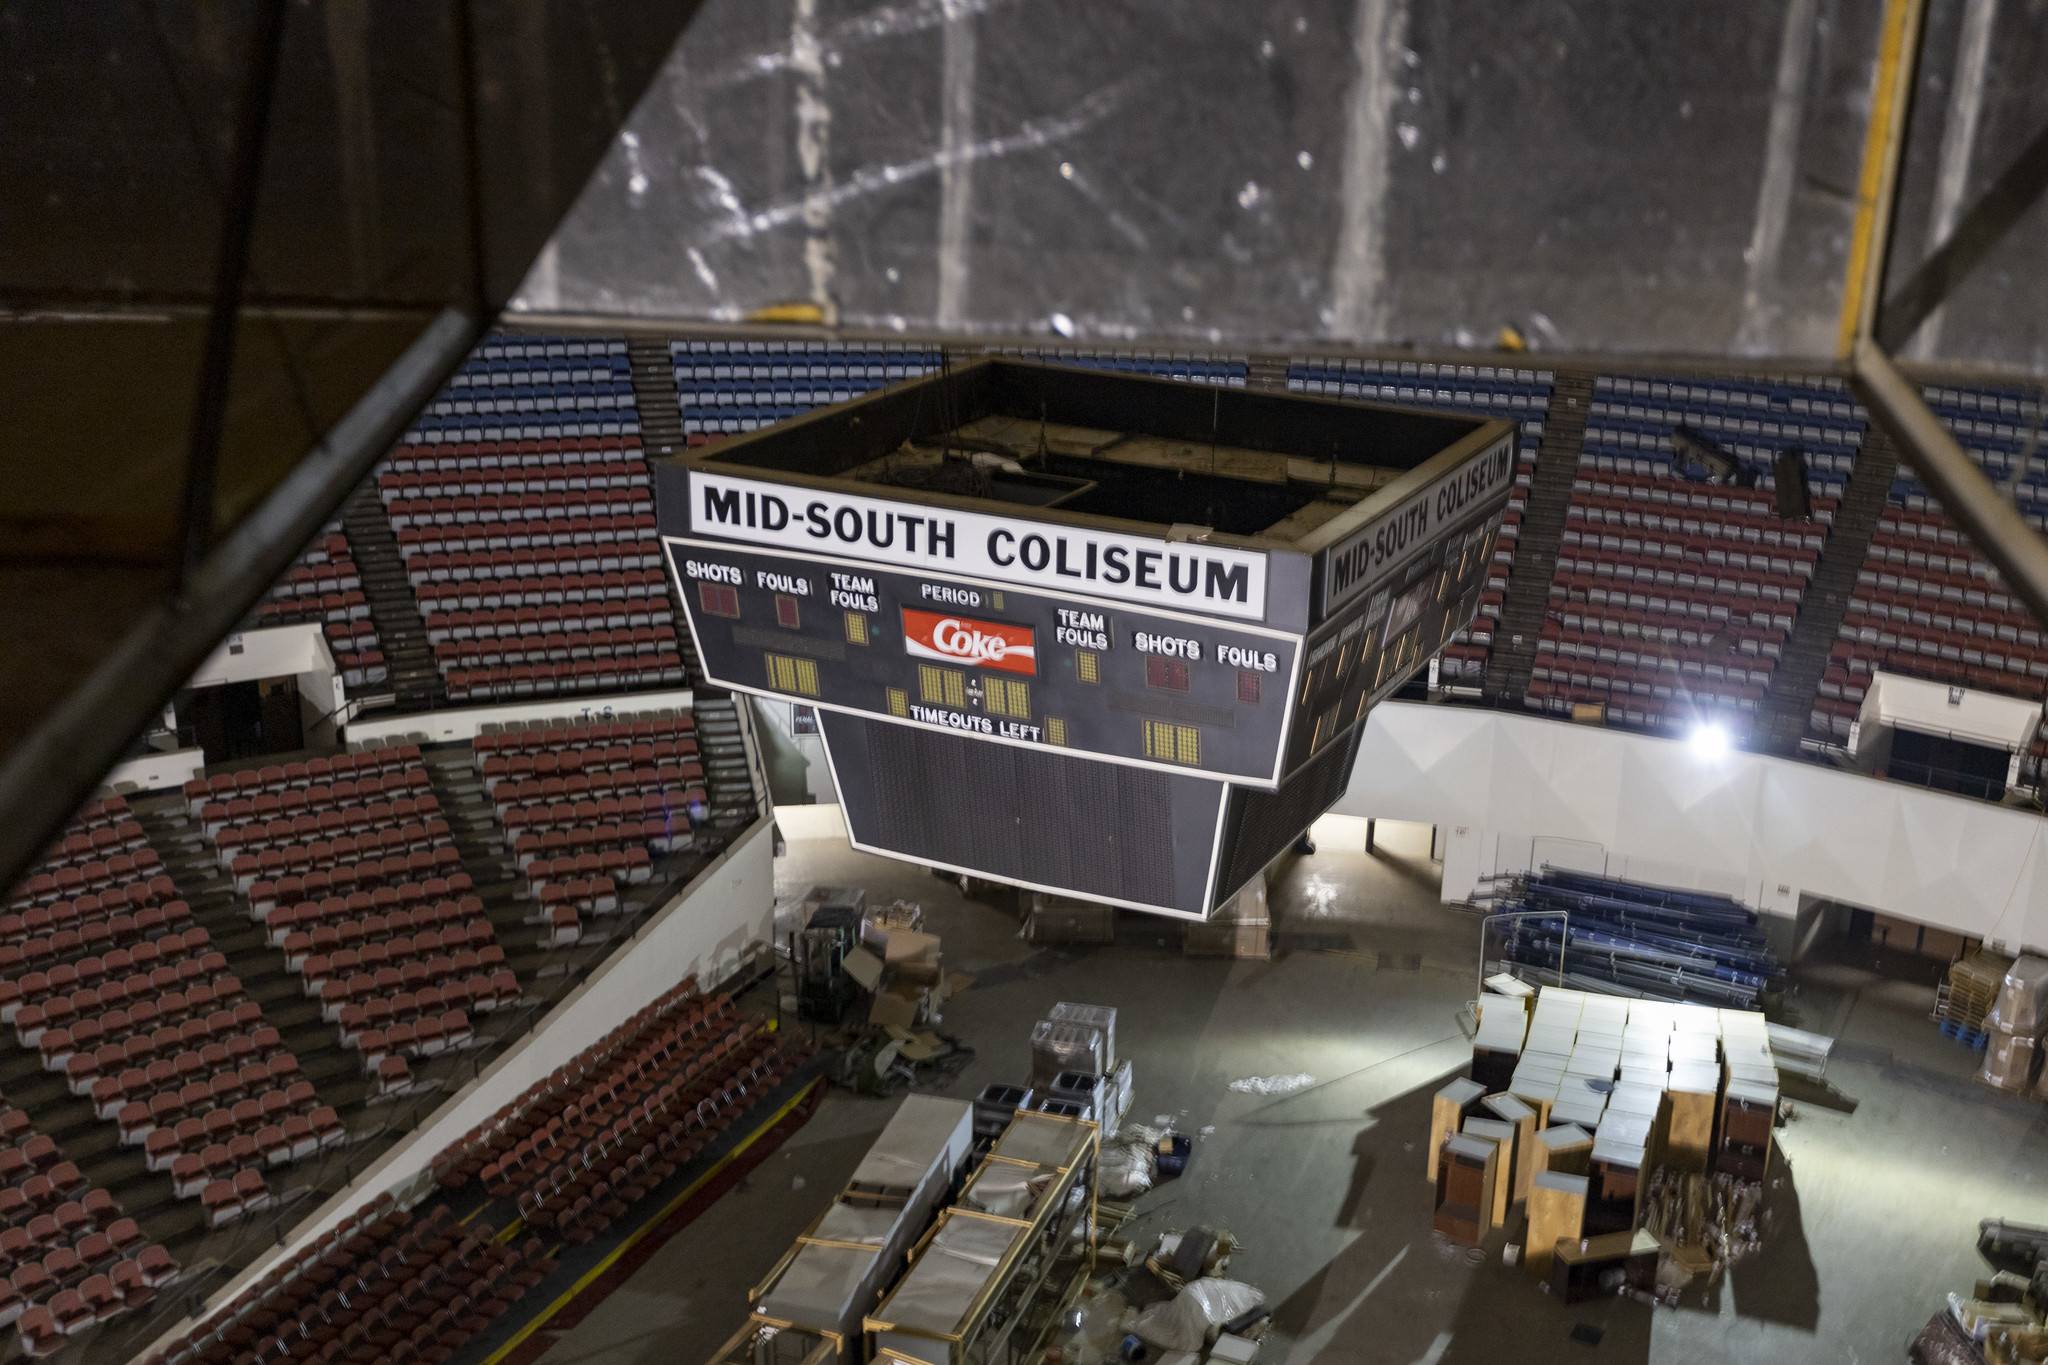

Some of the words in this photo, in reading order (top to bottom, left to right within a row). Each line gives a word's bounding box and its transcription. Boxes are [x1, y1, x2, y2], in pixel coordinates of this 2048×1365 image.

[1333, 496, 1429, 596] MID-SOUTH
[1437, 445, 1509, 521] COLISEUM
[703, 485, 955, 558] MID-SOUTH
[986, 527, 1250, 603] COLISEUM
[685, 560, 743, 585] SHOTS
[756, 571, 809, 596] FOULS
[830, 573, 874, 594] TEAM
[830, 589, 879, 612] FOULS
[921, 583, 981, 607] PERIOD
[1057, 608, 1104, 632] TEAM
[932, 618, 1006, 662] Coke
[1056, 626, 1108, 650] FOULS
[1135, 632, 1200, 660] SHOTS
[1217, 645, 1278, 672] FOULS
[910, 704, 993, 734] TIMEOUTS
[999, 720, 1041, 742] LEFT
